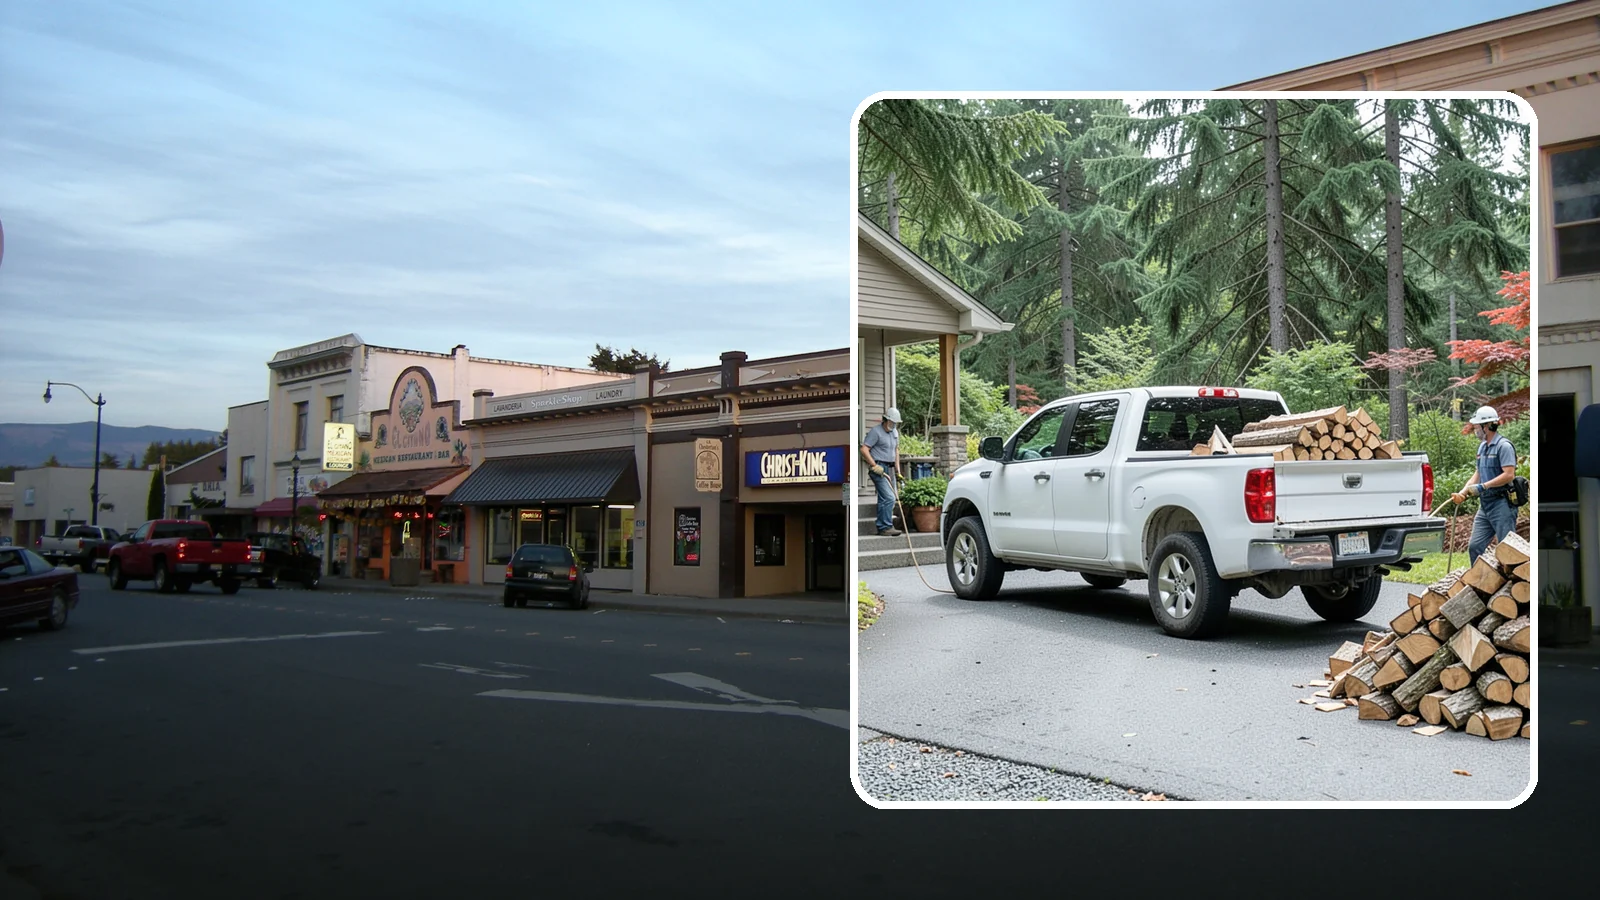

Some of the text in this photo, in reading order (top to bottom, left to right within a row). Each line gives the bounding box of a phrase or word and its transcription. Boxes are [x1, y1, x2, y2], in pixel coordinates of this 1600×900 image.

[595, 388, 624, 400] LAUNDRY
[493, 402, 523, 413] LAVANDERIA
[531, 395, 582, 408] Sparkle Shop
[373, 455, 396, 464] MEXICAN
[397, 451, 433, 462] RESTAURANT
[438, 450, 450, 459] BAR
[760, 452, 796, 478] CHRIST
[697, 480, 722, 489] Coffee House
